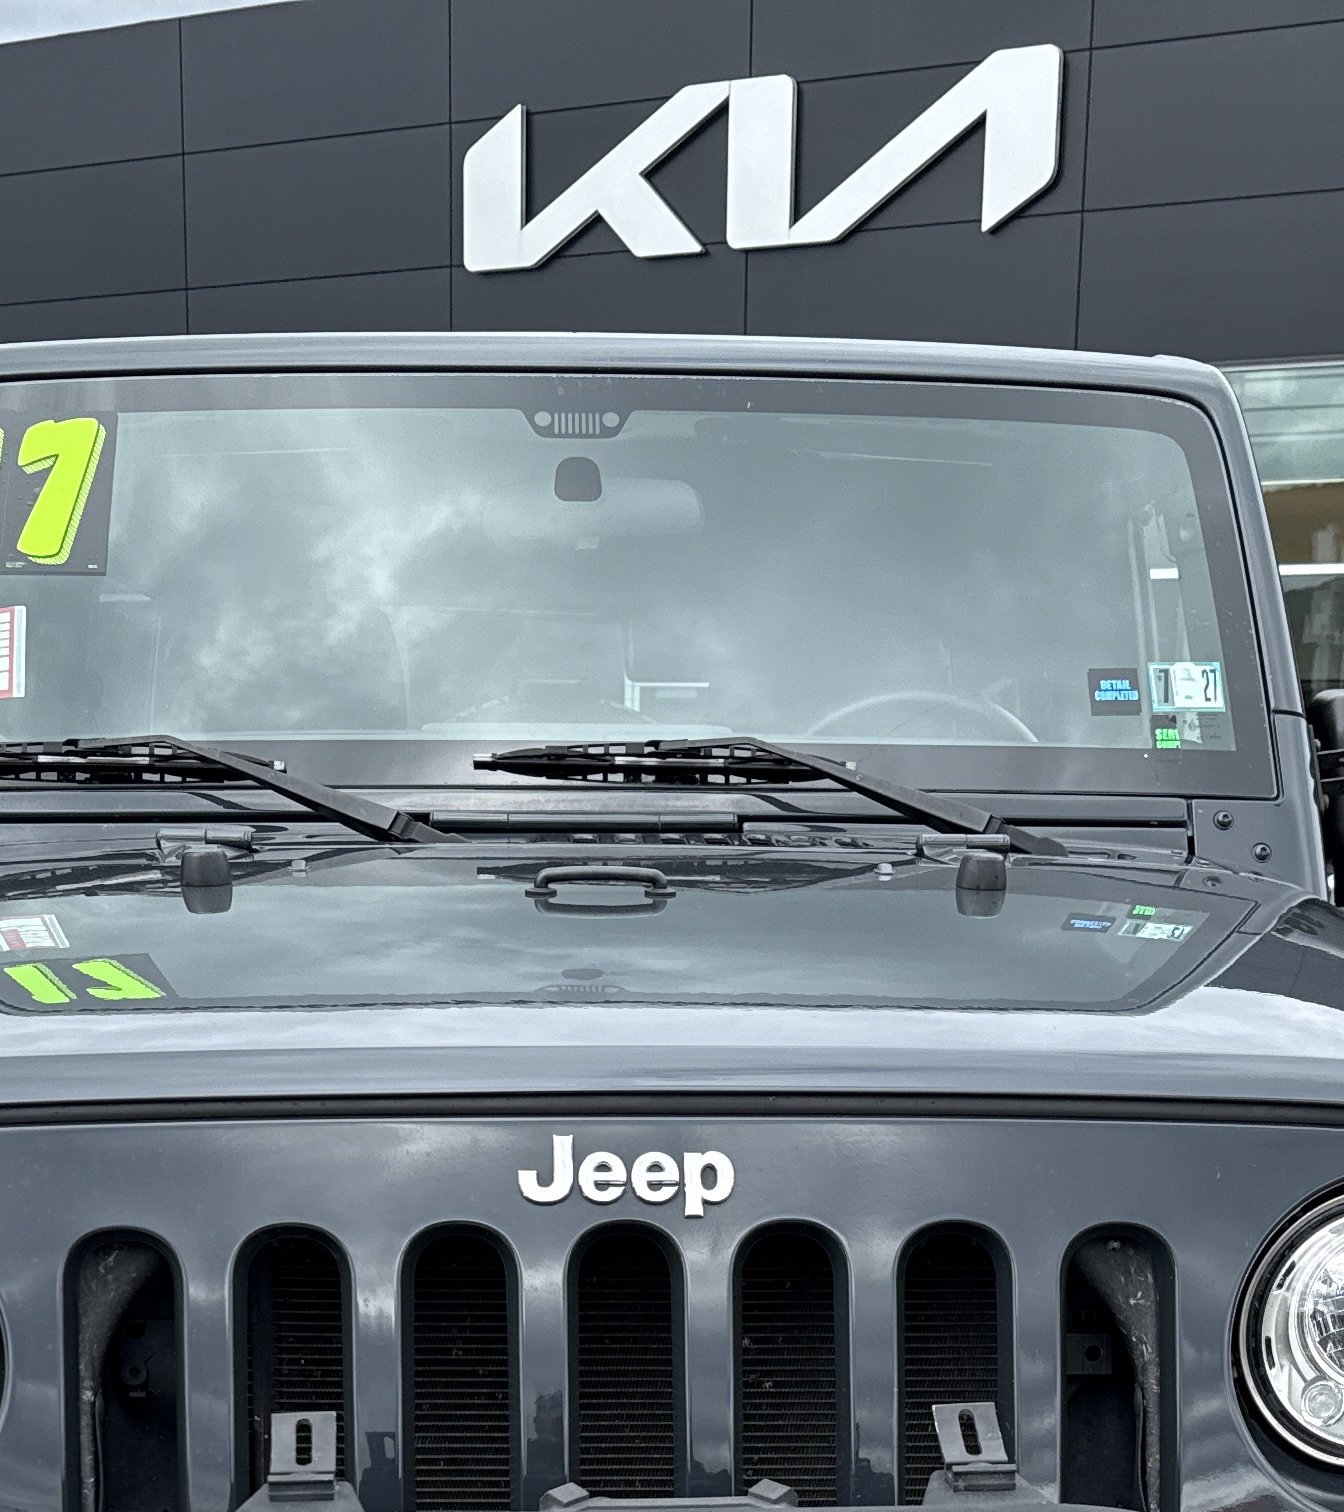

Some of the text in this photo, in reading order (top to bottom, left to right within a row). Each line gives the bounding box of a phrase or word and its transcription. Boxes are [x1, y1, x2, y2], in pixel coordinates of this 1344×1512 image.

[463, 44, 1063, 273] KIA
[1094, 690, 1139, 701] COMPLETED
[1099, 680, 1131, 690] DETAIL
[518, 1134, 735, 1219] Jeep
